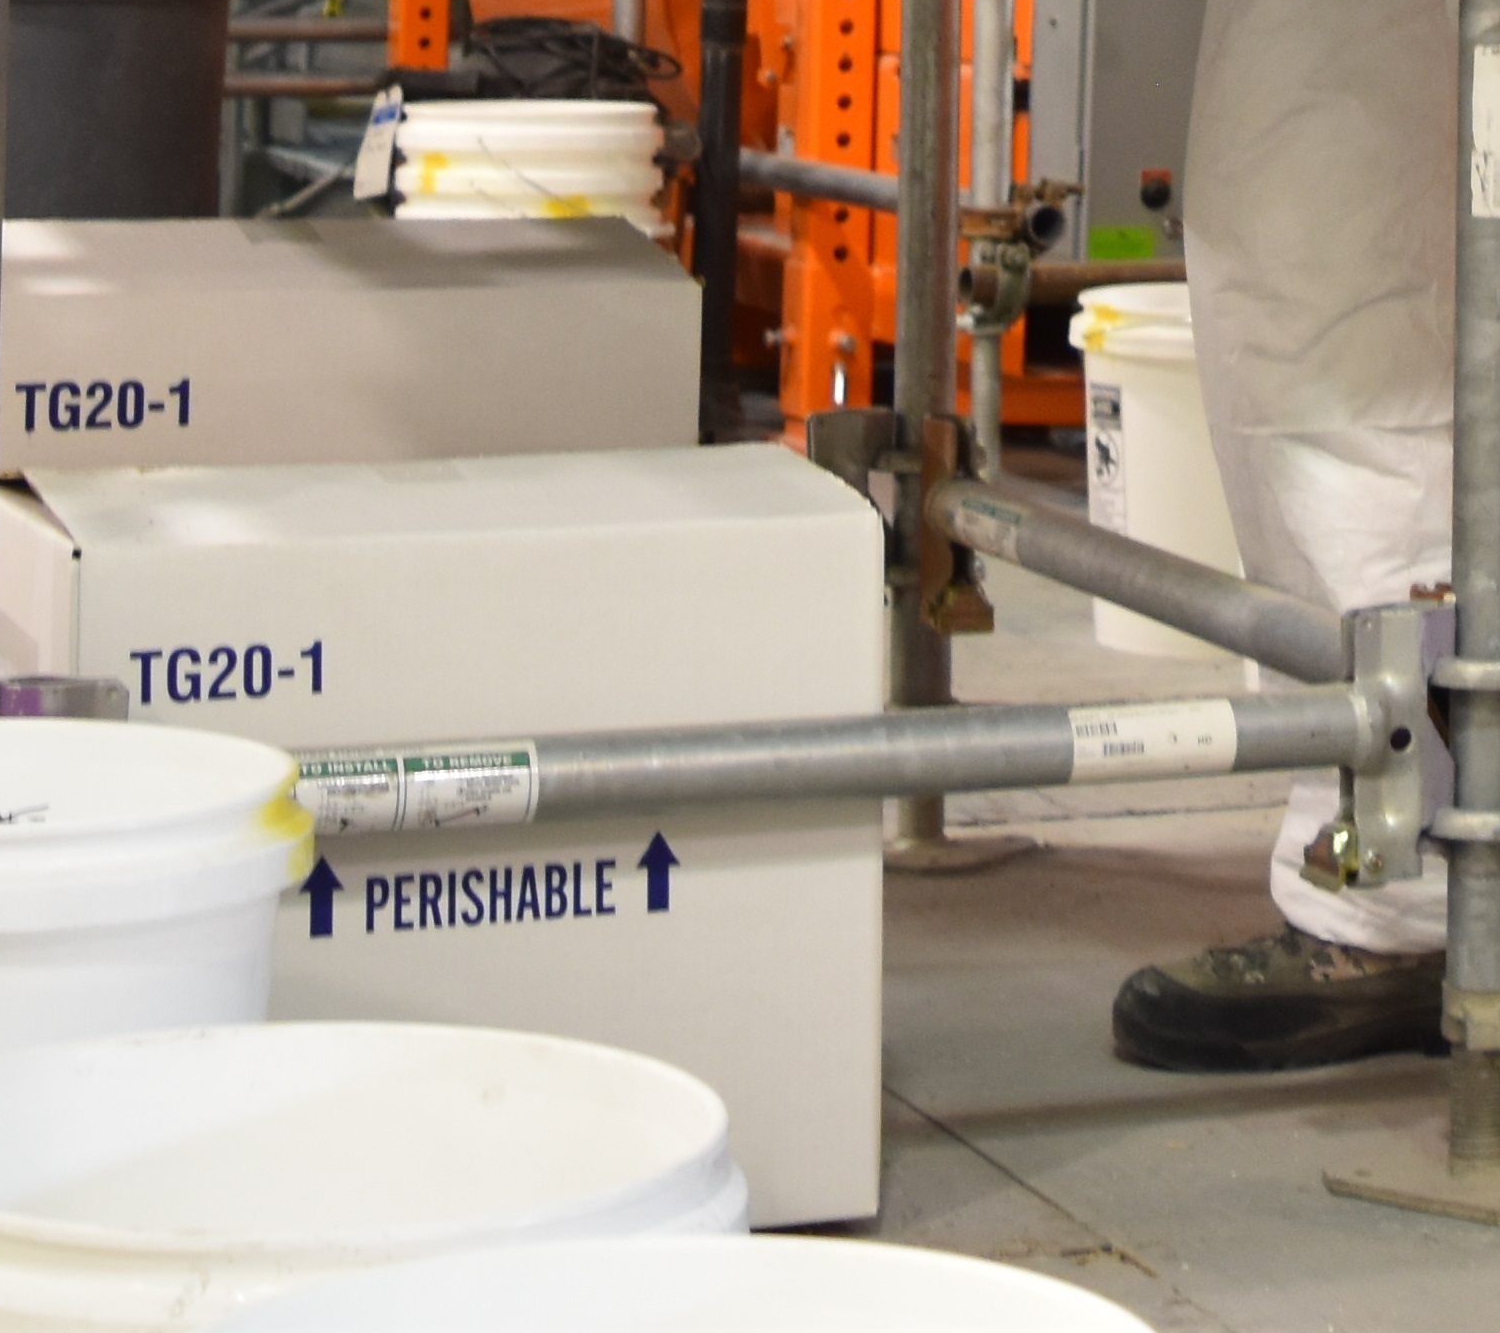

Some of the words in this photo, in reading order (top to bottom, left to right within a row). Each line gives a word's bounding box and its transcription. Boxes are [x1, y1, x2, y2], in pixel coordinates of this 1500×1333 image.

[15, 378, 191, 433] TG20-1
[129, 640, 323, 705] TG20-1
[328, 759, 389, 775] INSTALL
[449, 753, 512, 769] REMOVE
[365, 857, 616, 934] PERISHABLE
